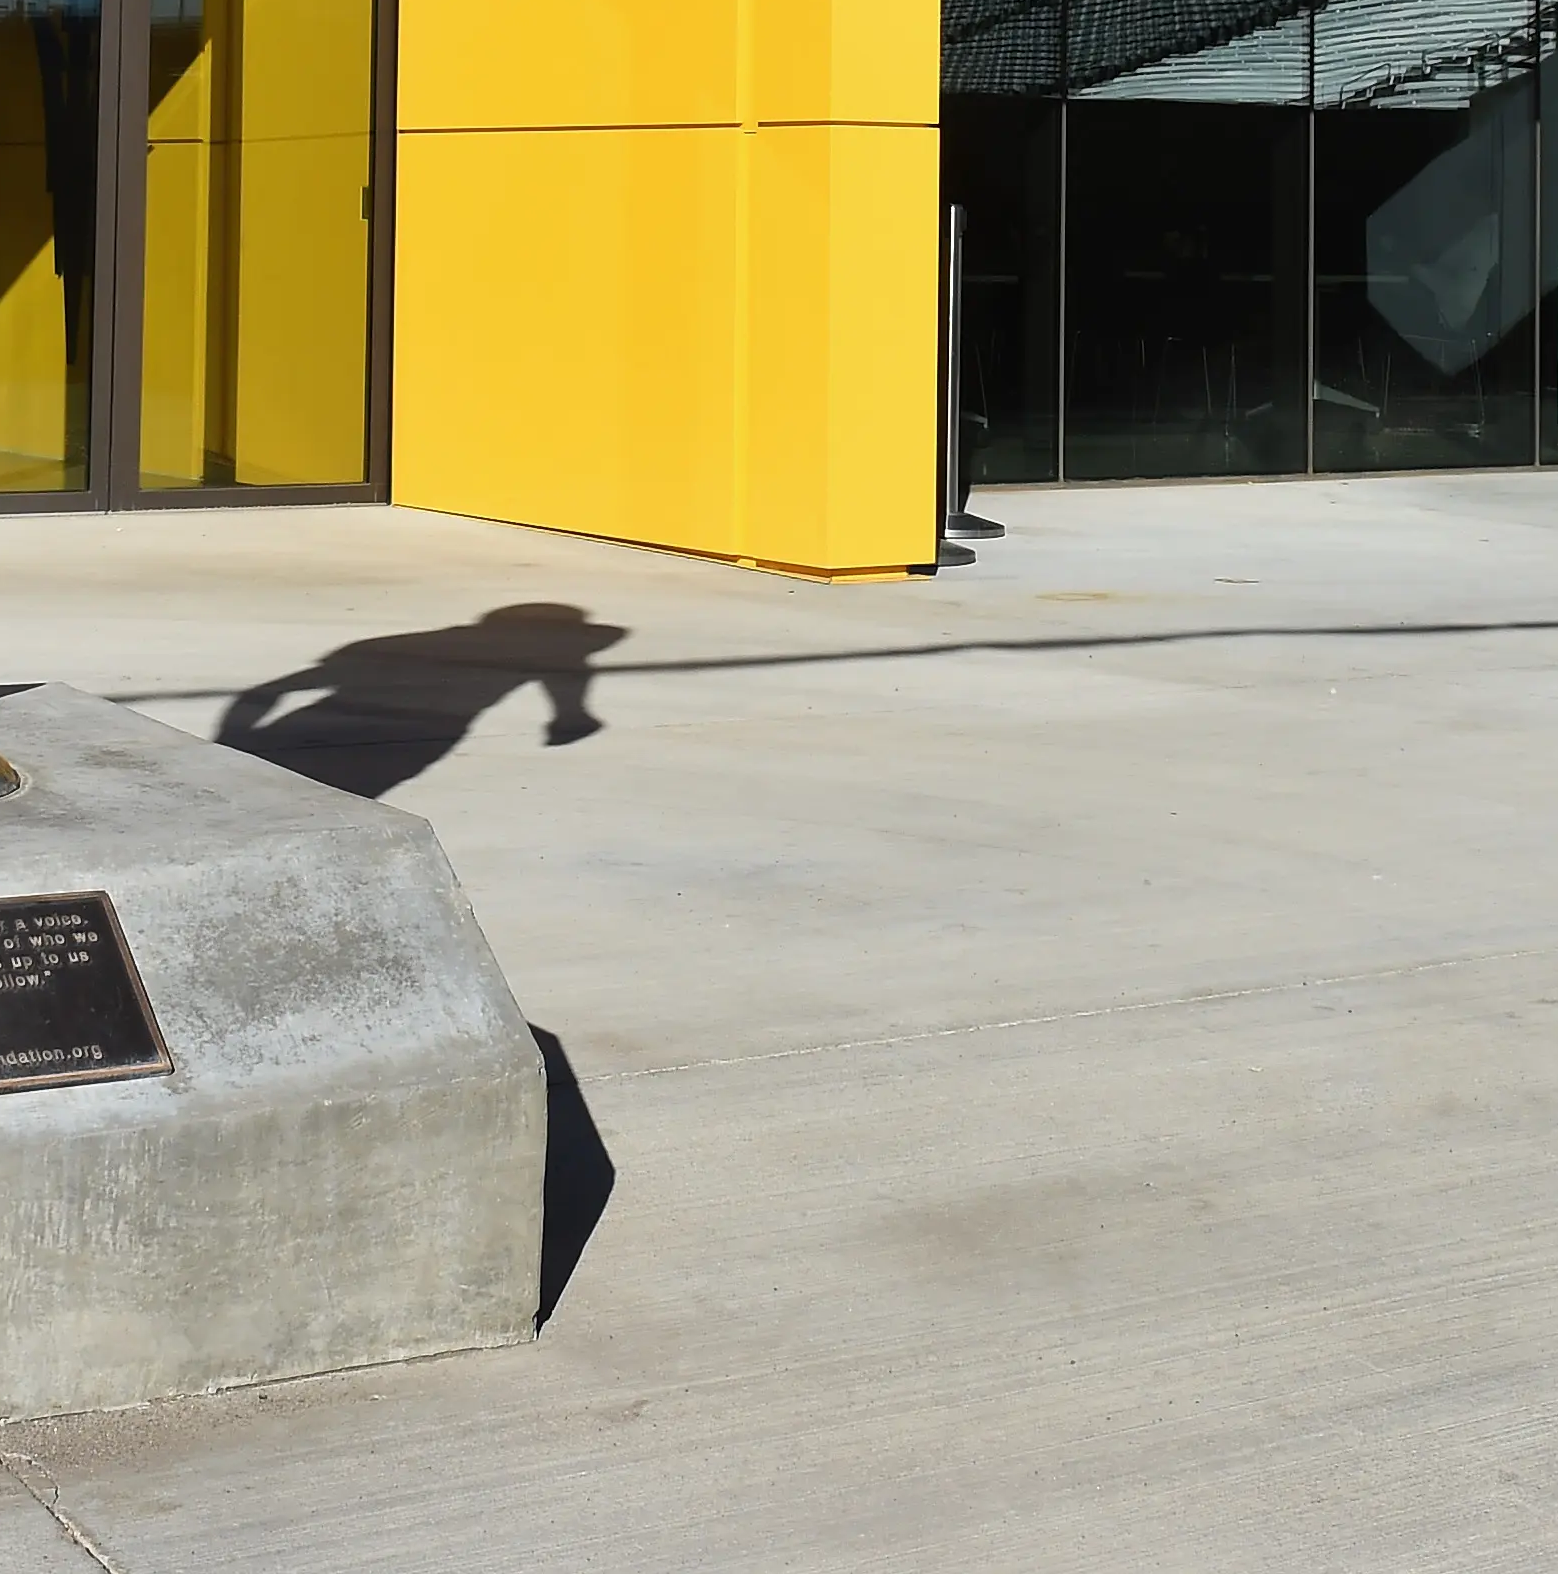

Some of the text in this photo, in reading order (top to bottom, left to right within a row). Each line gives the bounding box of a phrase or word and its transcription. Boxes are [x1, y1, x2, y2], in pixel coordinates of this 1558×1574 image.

[15, 918, 28, 931] a
[34, 912, 89, 927] voice.
[3, 934, 21, 949] of
[29, 930, 65, 948] who
[72, 930, 99, 944] we
[11, 955, 33, 970] up
[41, 951, 60, 966] to
[68, 949, 90, 964] us
